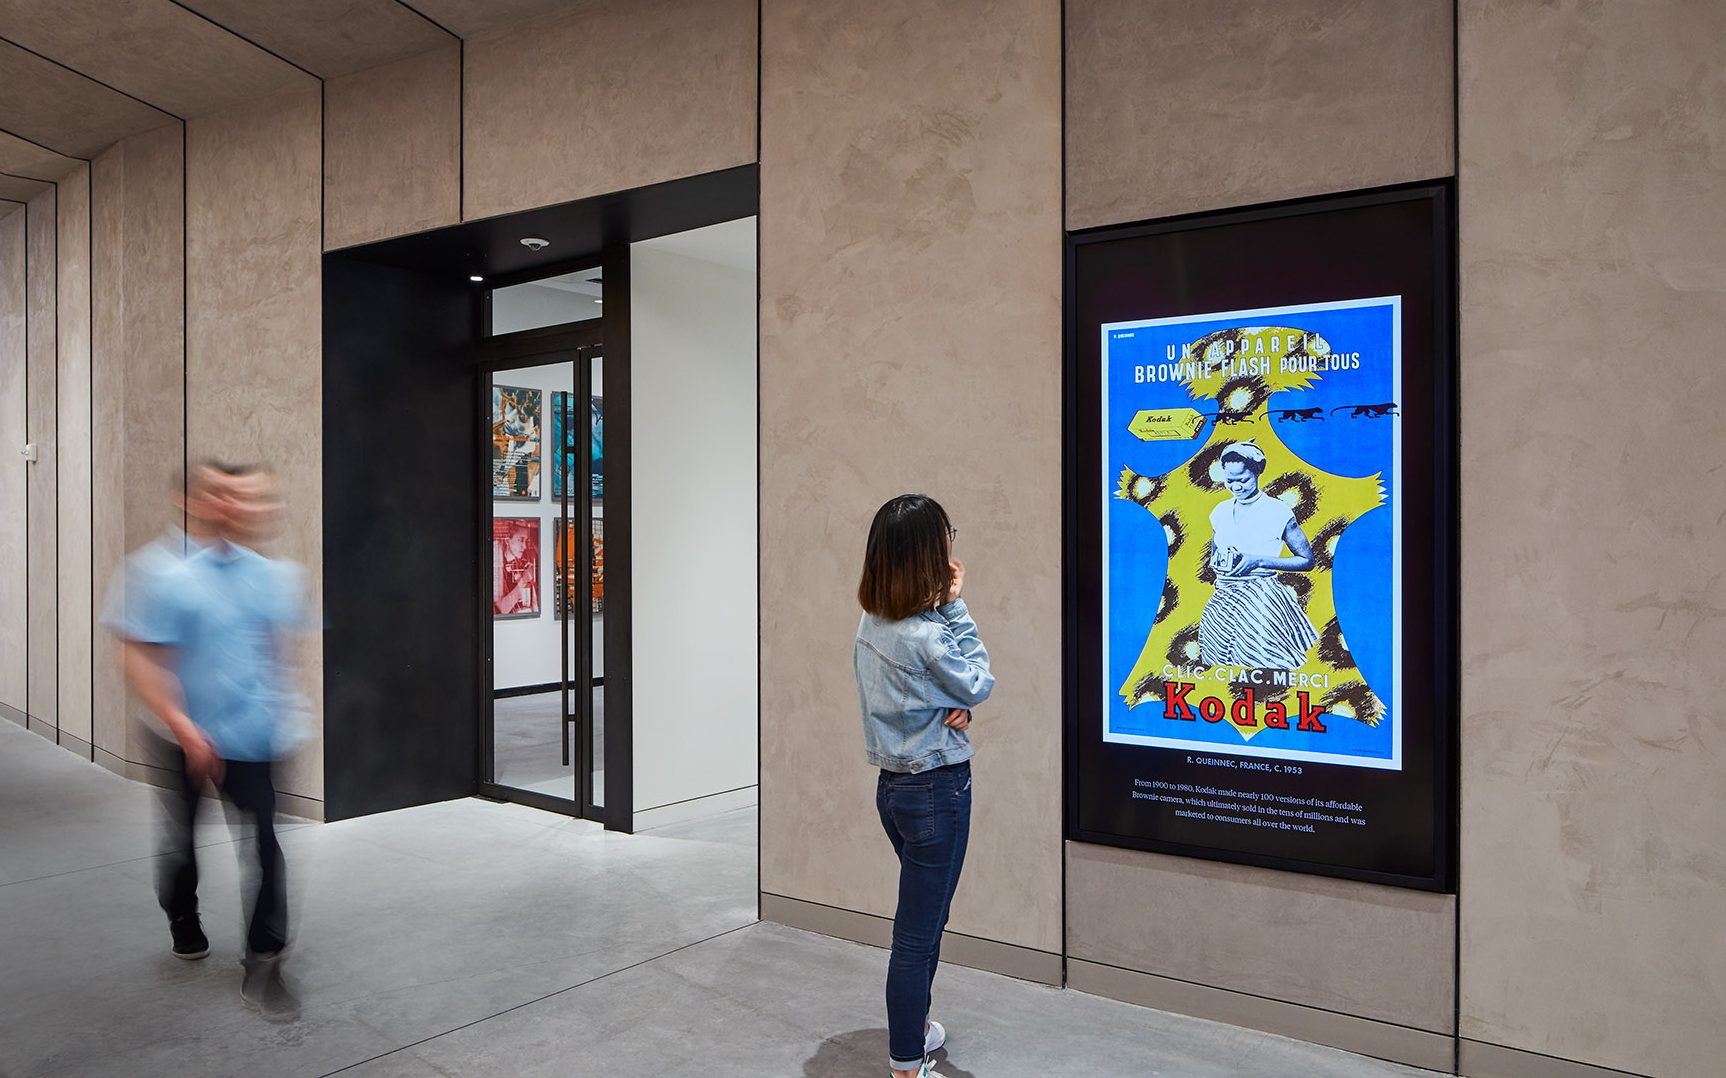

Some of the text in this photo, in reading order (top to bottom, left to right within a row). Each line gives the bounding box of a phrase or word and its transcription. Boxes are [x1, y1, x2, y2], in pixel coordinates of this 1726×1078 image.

[1166, 333, 1323, 361] UN APPAREIL
[1134, 351, 1361, 384] BROWNIE FLASH POUR TOUS
[1146, 415, 1172, 423] Kodak
[1163, 681, 1327, 733] Kodak
[1186, 755, 1303, 775] R. QUEINNEC, FRANCE, C. 1953
[1131, 790, 1159, 801] Brownie
[1185, 797, 1207, 807] which
[1206, 799, 1242, 812] ultimately
[1241, 804, 1257, 813] sold
[1257, 805, 1266, 814] in
[1266, 806, 1279, 815] the
[1278, 809, 1295, 818] tens
[1294, 810, 1304, 819] of
[1303, 812, 1334, 823] millions
[1334, 815, 1350, 824] and
[1350, 816, 1367, 826] was
[1134, 778, 1152, 787] From
[1152, 781, 1169, 789] 1900
[1169, 783, 1177, 791] to
[1195, 785, 1218, 796] Kodak
[1217, 788, 1237, 798] made
[1237, 791, 1260, 800] nearly
[1260, 793, 1275, 802] 100
[1275, 795, 1306, 806] versions
[1305, 798, 1315, 806] of
[1315, 799, 1325, 808] its
[1325, 800, 1363, 812] affordable
[1174, 808, 1316, 834] marketed to consumers all over the world.
